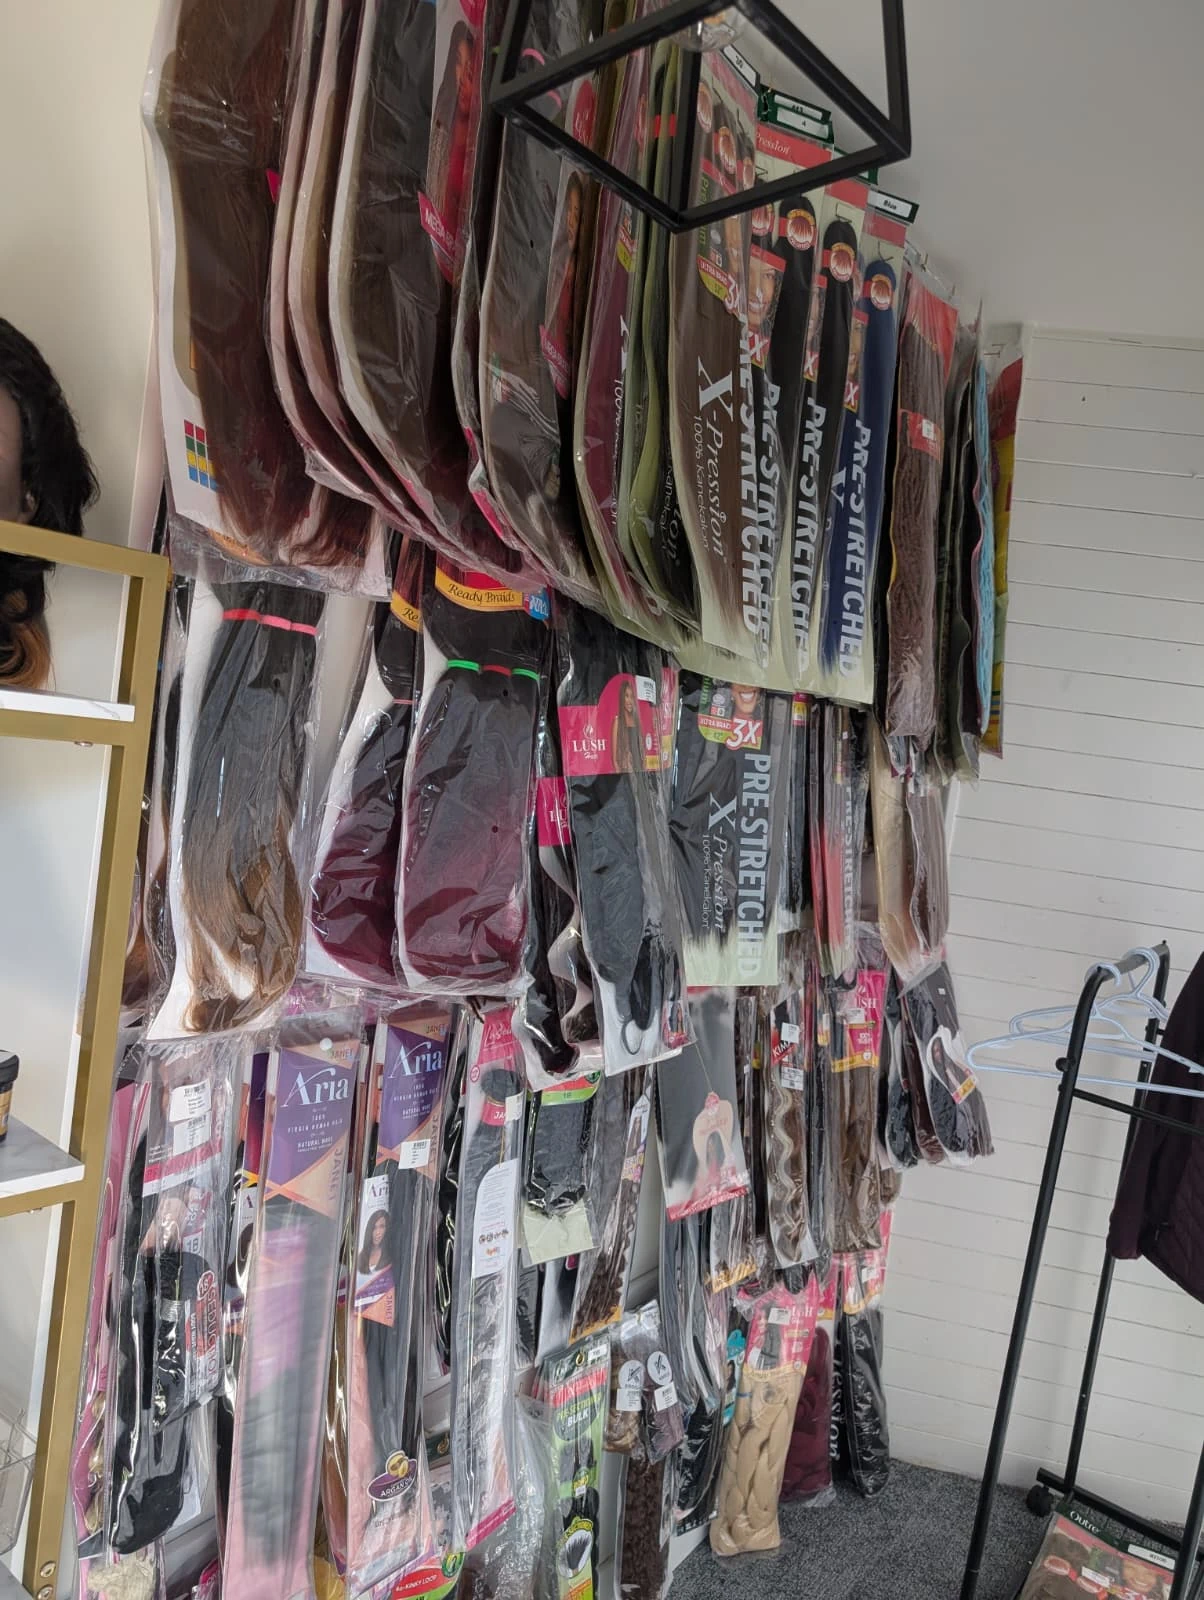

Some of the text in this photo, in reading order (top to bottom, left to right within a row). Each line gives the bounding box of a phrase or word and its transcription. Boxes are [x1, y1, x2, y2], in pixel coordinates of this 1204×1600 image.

[693, 415, 704, 460] 100%
[791, 397, 827, 673] PRE-STRETCHED
[839, 419, 872, 679] PRE-STRETCHED
[449, 583, 482, 606] Ready
[573, 738, 606, 752] LUSH
[726, 718, 760, 748] 3X
[737, 752, 771, 977] PRE-STRETCHED
[388, 1041, 443, 1079] Aria
[280, 1067, 349, 1108] Aria
[367, 1182, 390, 1198] Ari
[1070, 1510, 1100, 1534] Outre
